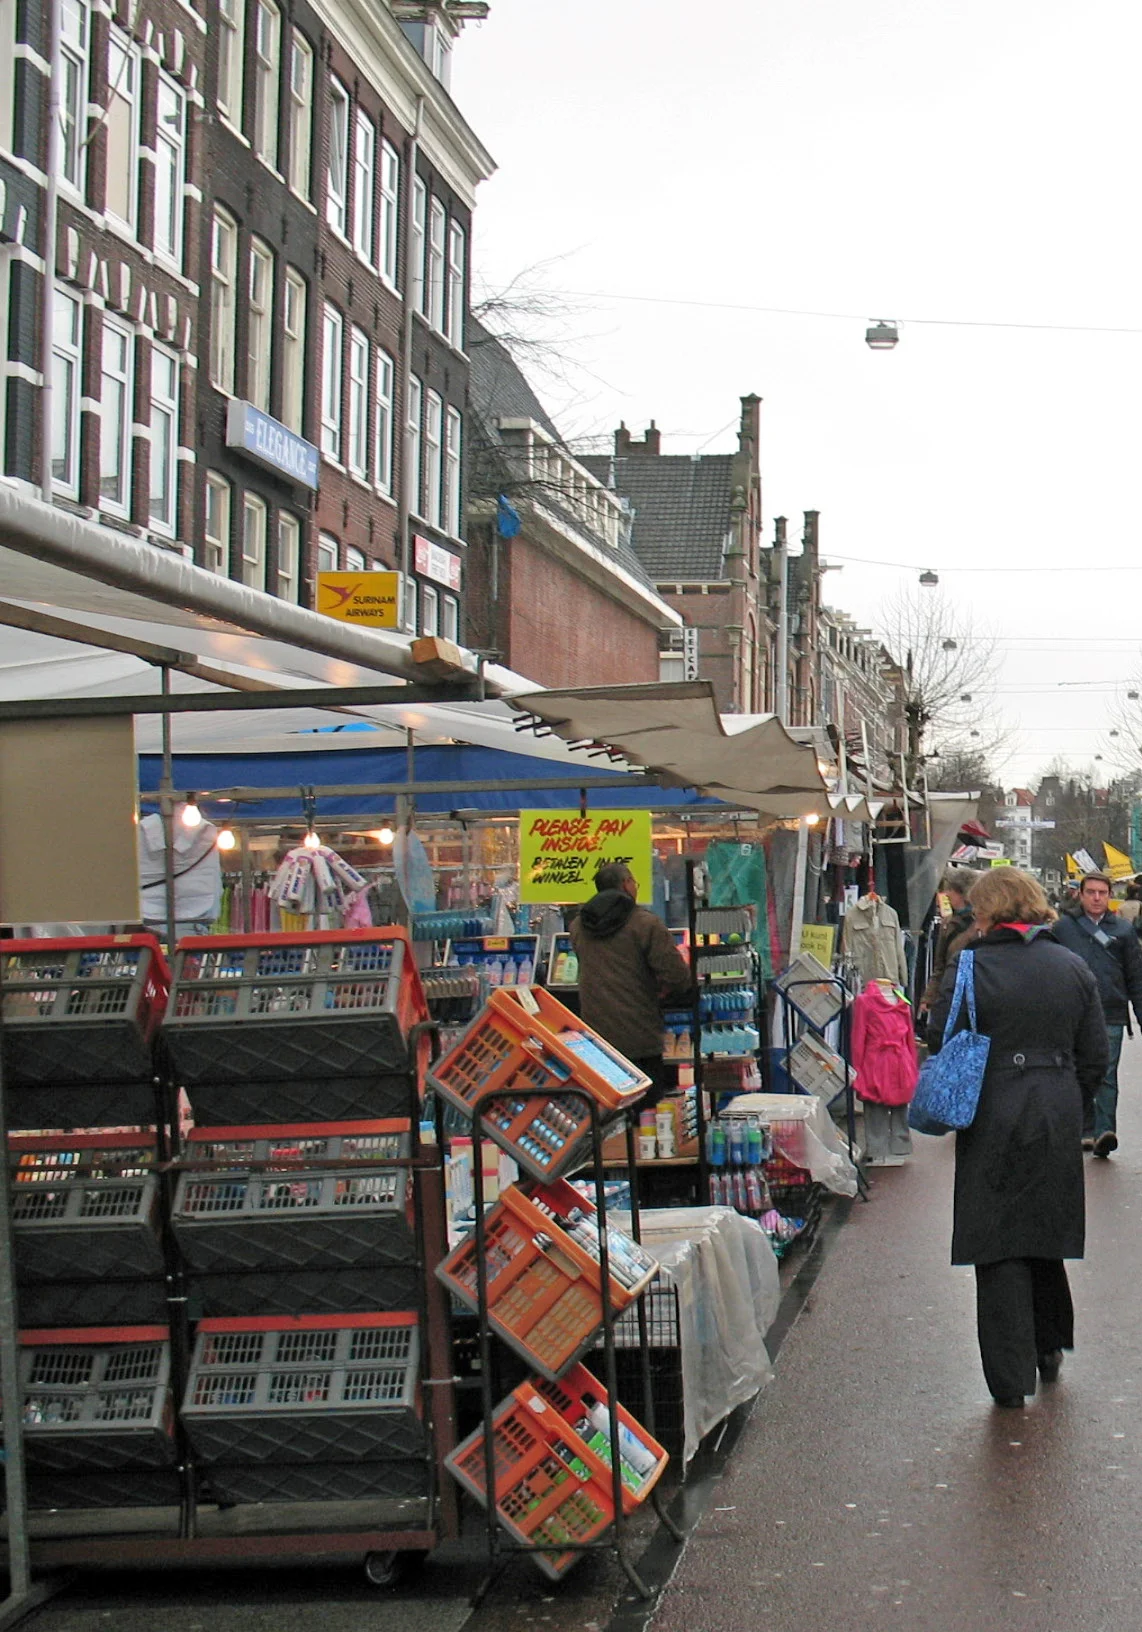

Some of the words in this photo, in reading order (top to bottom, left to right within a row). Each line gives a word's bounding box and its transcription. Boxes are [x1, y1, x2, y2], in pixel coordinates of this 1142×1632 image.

[256, 418, 307, 478] ELEGANCE
[353, 596, 396, 604] SURINAM
[346, 608, 384, 616] AIRWAYS
[529, 818, 593, 837] PLEASE
[595, 818, 634, 837] PAY
[540, 837, 608, 853] INSIDE!
[531, 856, 588, 870] BETALEN
